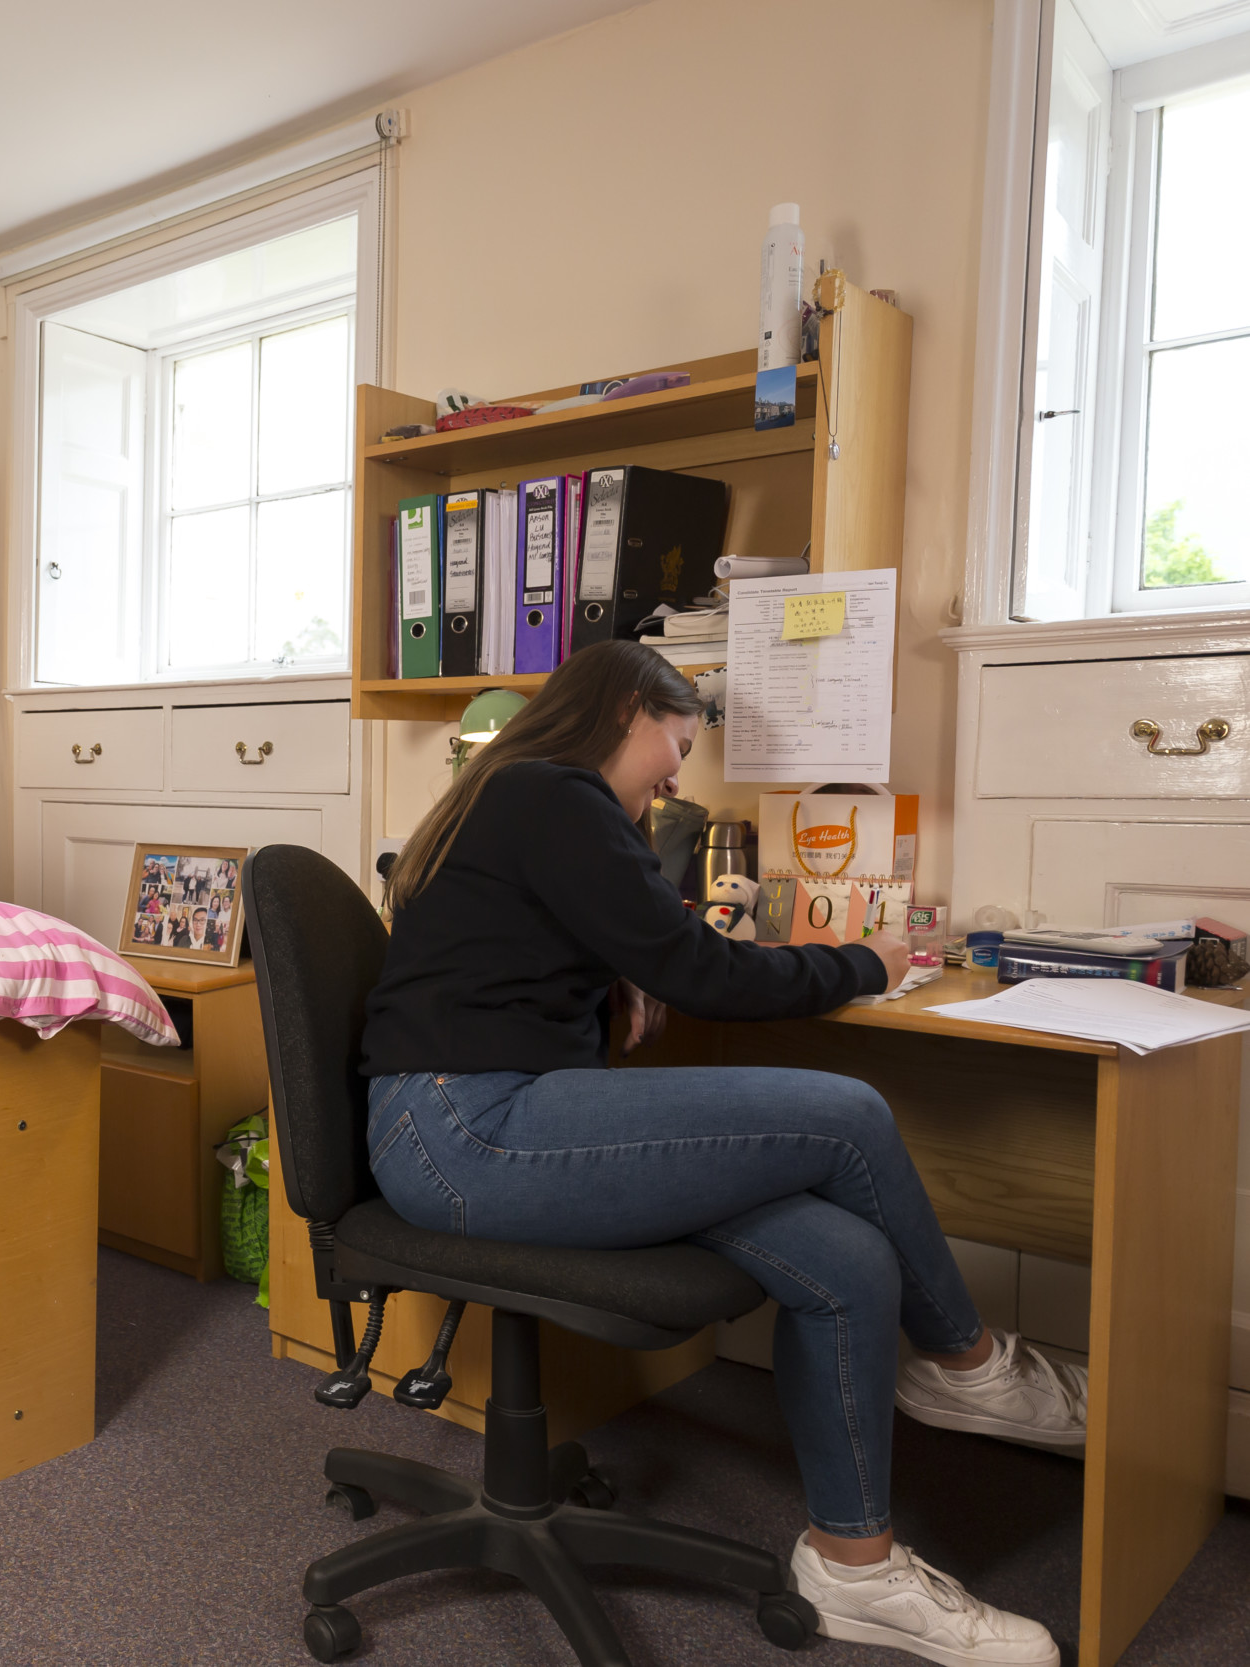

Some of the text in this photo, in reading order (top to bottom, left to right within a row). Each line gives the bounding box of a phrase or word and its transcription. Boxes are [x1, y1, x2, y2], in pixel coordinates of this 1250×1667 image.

[599, 475, 614, 488] IXL
[534, 485, 550, 500] IXL
[799, 829, 850, 846] Eye Health
